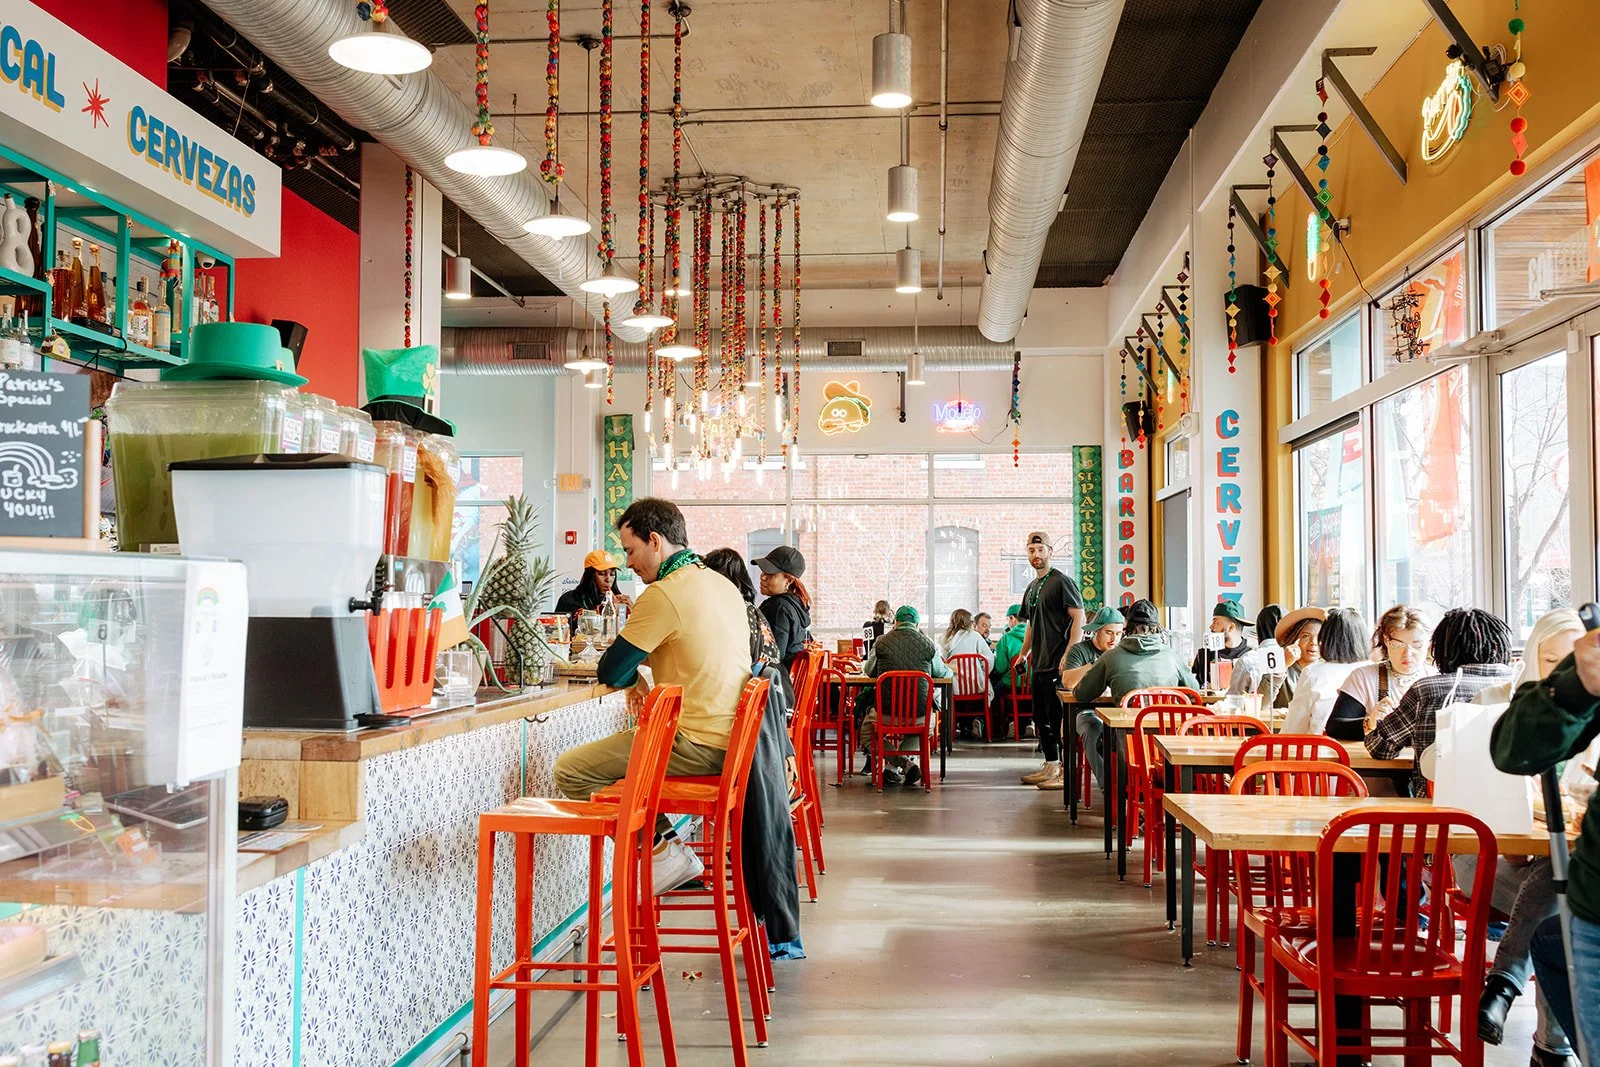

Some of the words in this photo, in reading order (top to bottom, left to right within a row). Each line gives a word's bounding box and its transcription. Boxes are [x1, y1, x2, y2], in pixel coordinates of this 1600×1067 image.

[0, 22, 64, 112] CAL
[127, 105, 256, 218] CERVEZAS
[559, 474, 581, 491] EXIT
[1077, 472, 1098, 482] ST.
[1079, 483, 1097, 586] PATRICKS
[864, 628, 873, 639] 89
[1266, 652, 1277, 669] 6
